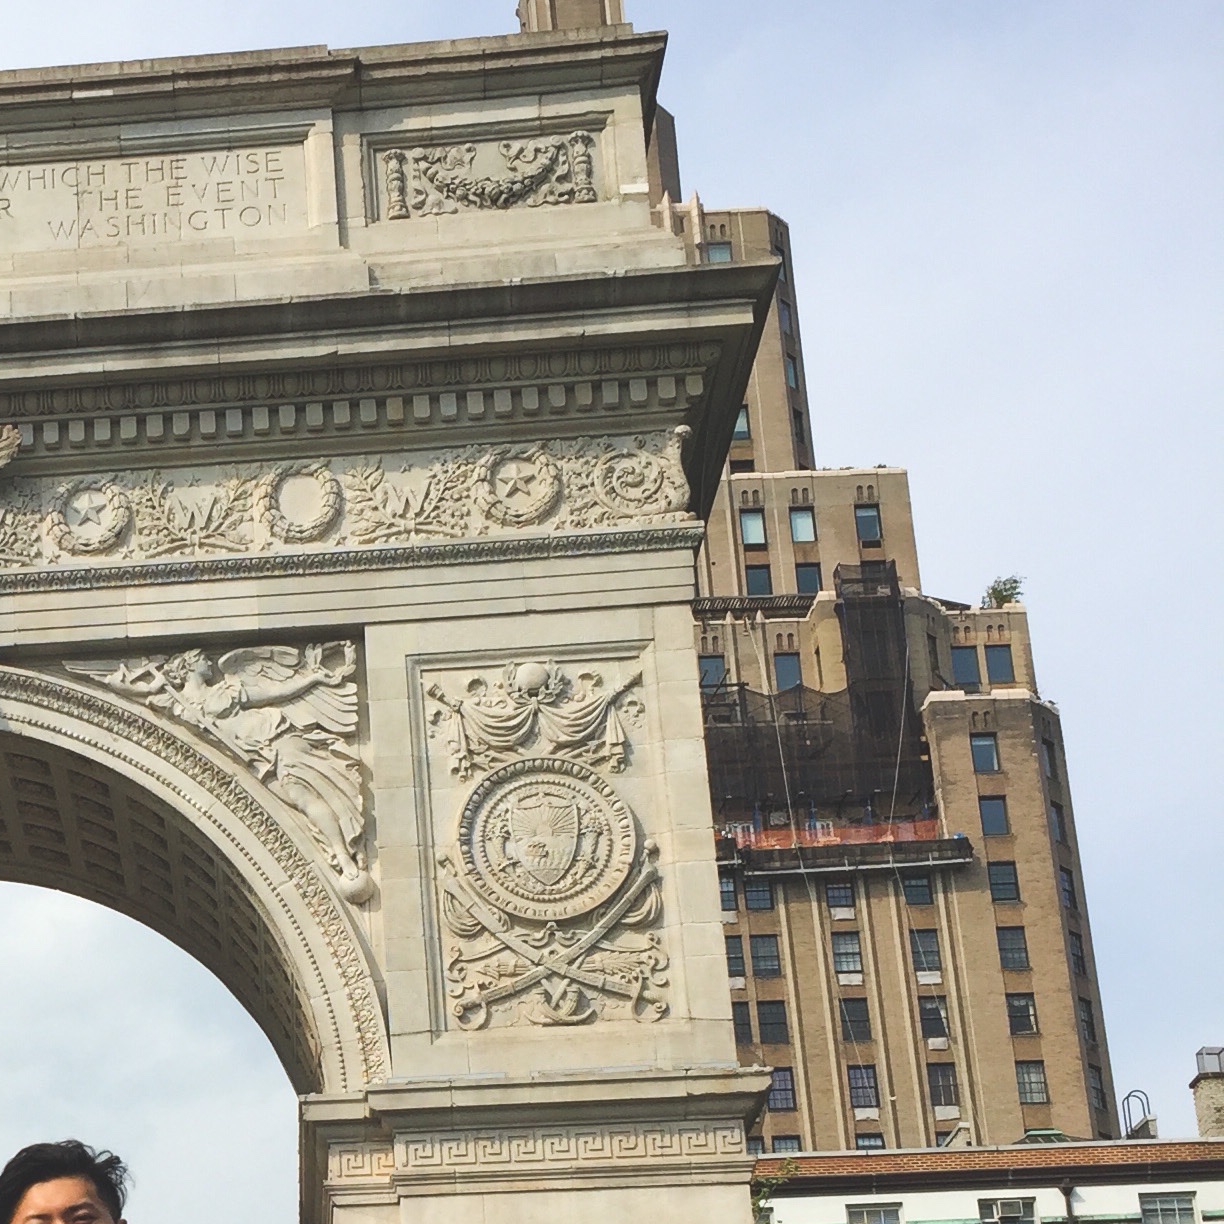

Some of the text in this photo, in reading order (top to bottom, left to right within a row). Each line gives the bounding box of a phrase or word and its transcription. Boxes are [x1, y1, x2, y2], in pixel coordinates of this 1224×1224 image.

[120, 158, 188, 183] THE
[200, 151, 284, 177] WISE
[166, 176, 285, 208] EVENT
[47, 204, 287, 241] WASHINGTON
